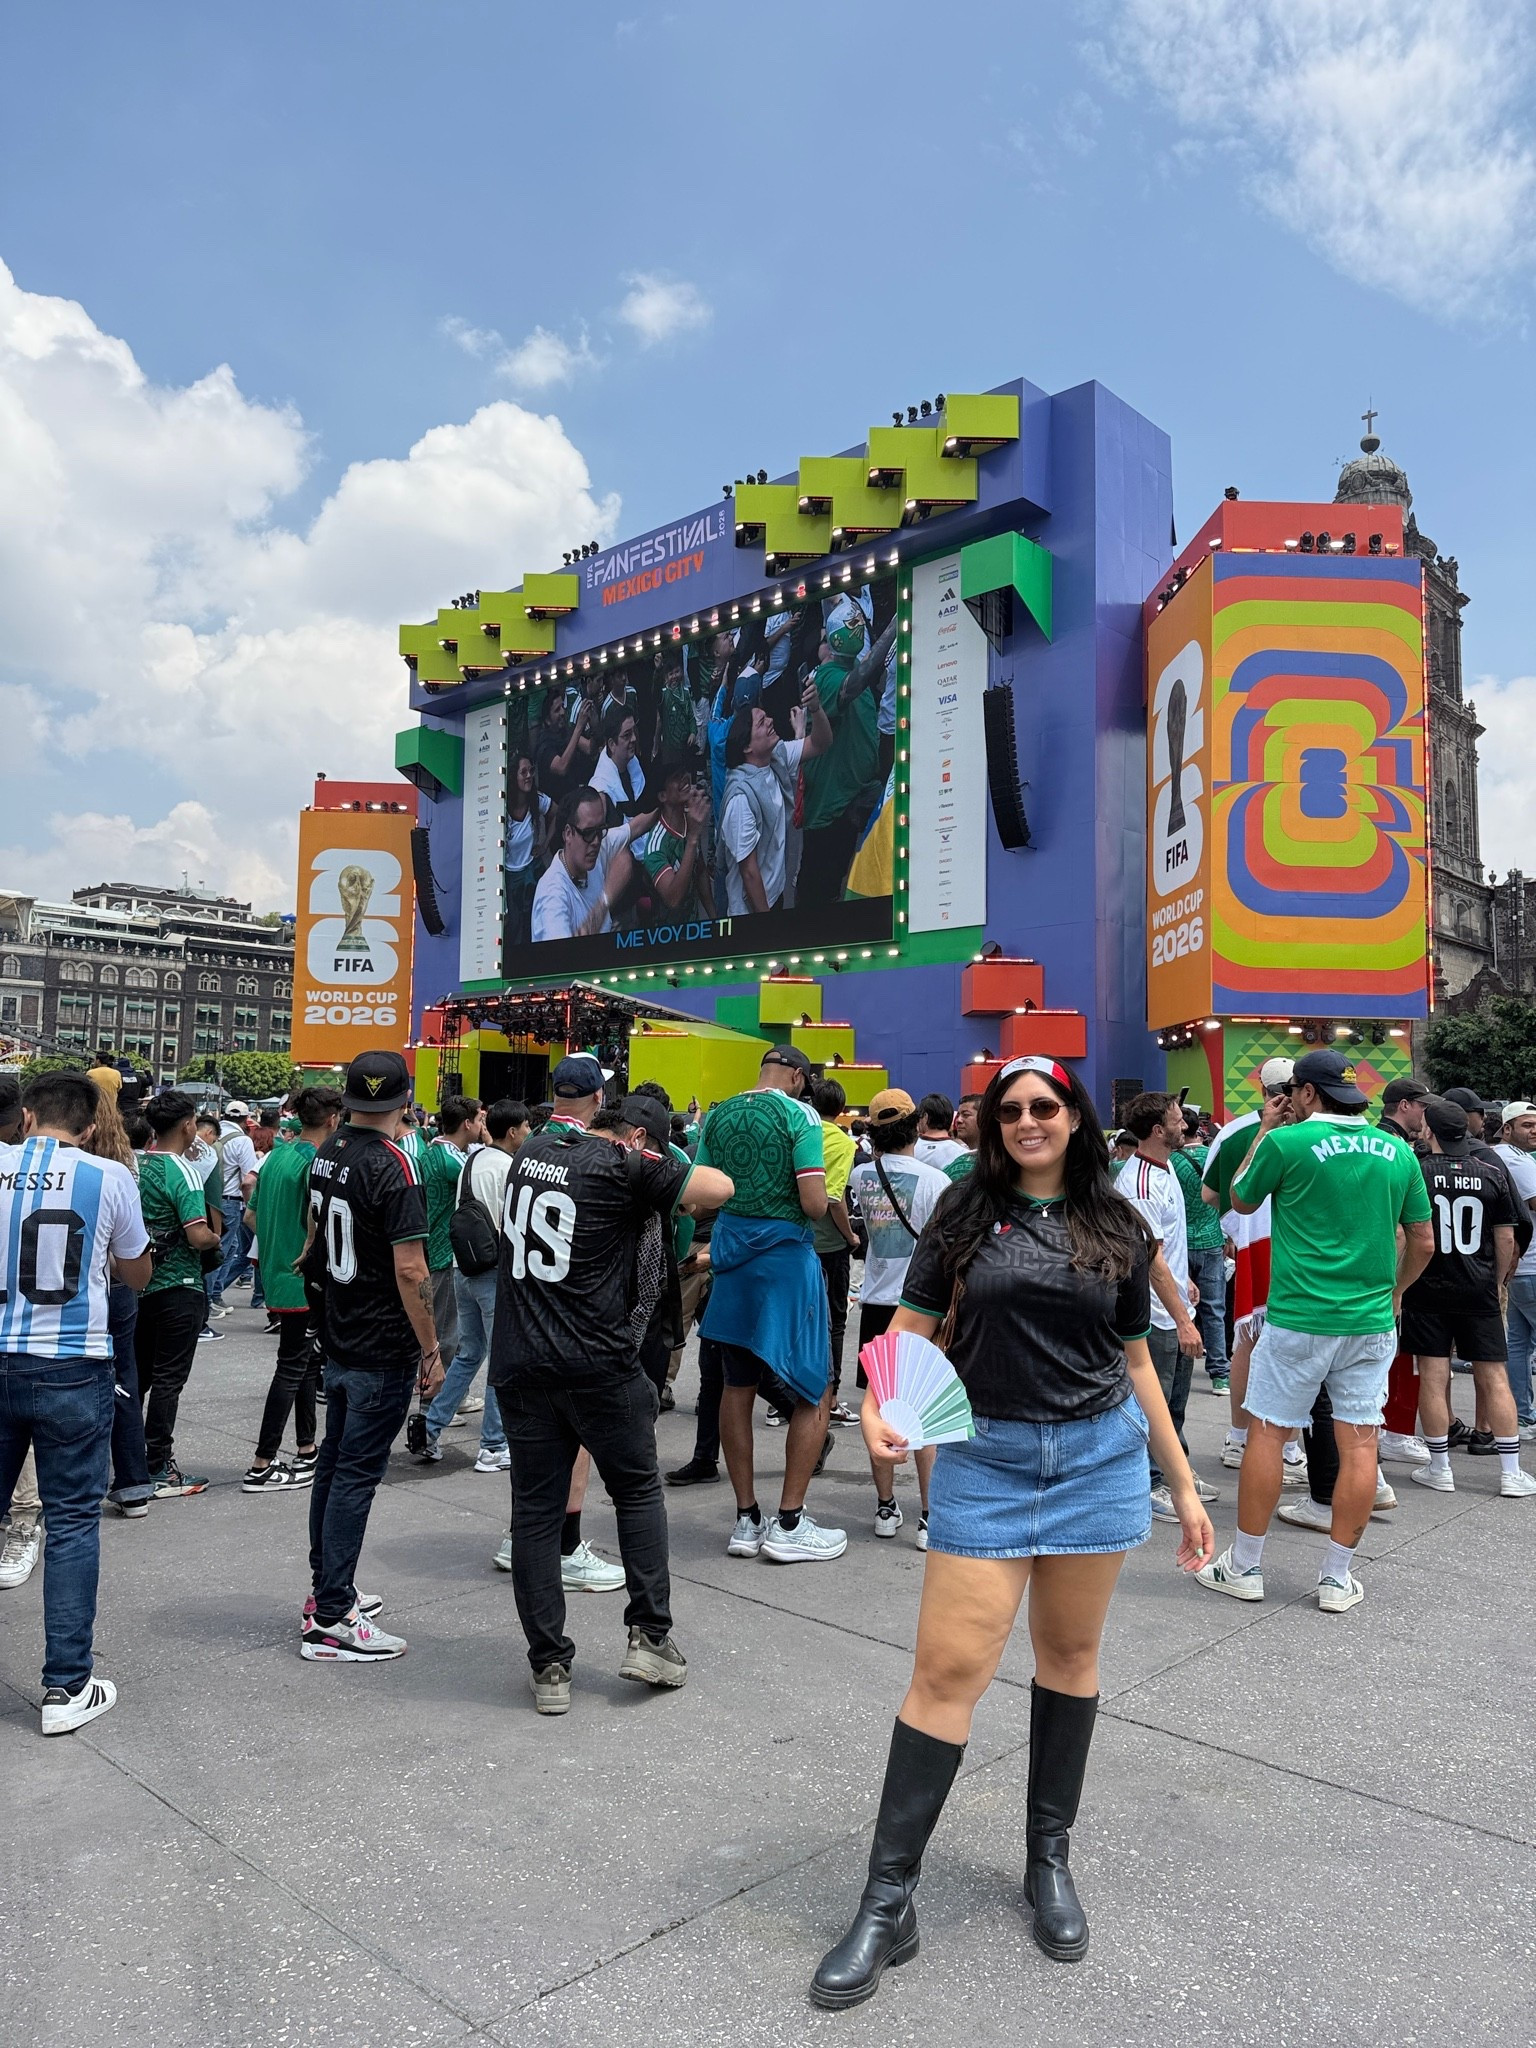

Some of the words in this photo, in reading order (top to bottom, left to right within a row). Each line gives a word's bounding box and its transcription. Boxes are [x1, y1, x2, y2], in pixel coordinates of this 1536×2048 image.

[603, 567, 663, 607] MEXICO
[664, 550, 704, 584] CITY
[938, 693, 958, 705] VISA
[1166, 845, 1189, 873] FIFA
[1152, 899, 1184, 931] WORLD
[1184, 888, 1203, 915] CUP
[616, 929, 645, 949] ME
[647, 924, 684, 945] VOY
[686, 920, 713, 941] DE
[715, 918, 732, 937] TI
[1152, 916, 1204, 968] 2026
[333, 958, 374, 972] FIFA
[305, 990, 364, 1003] WORLD
[366, 991, 398, 1004] CUP
[304, 1005, 397, 1026] 2026
[1310, 1135, 1397, 1163] MEXICO
[0, 1172, 66, 1191] MESSI
[517, 1157, 570, 1186] PARRAL
[1433, 1175, 1450, 1189] M.
[1454, 1175, 1483, 1191] HEID
[1433, 1194, 1484, 1255] 10
